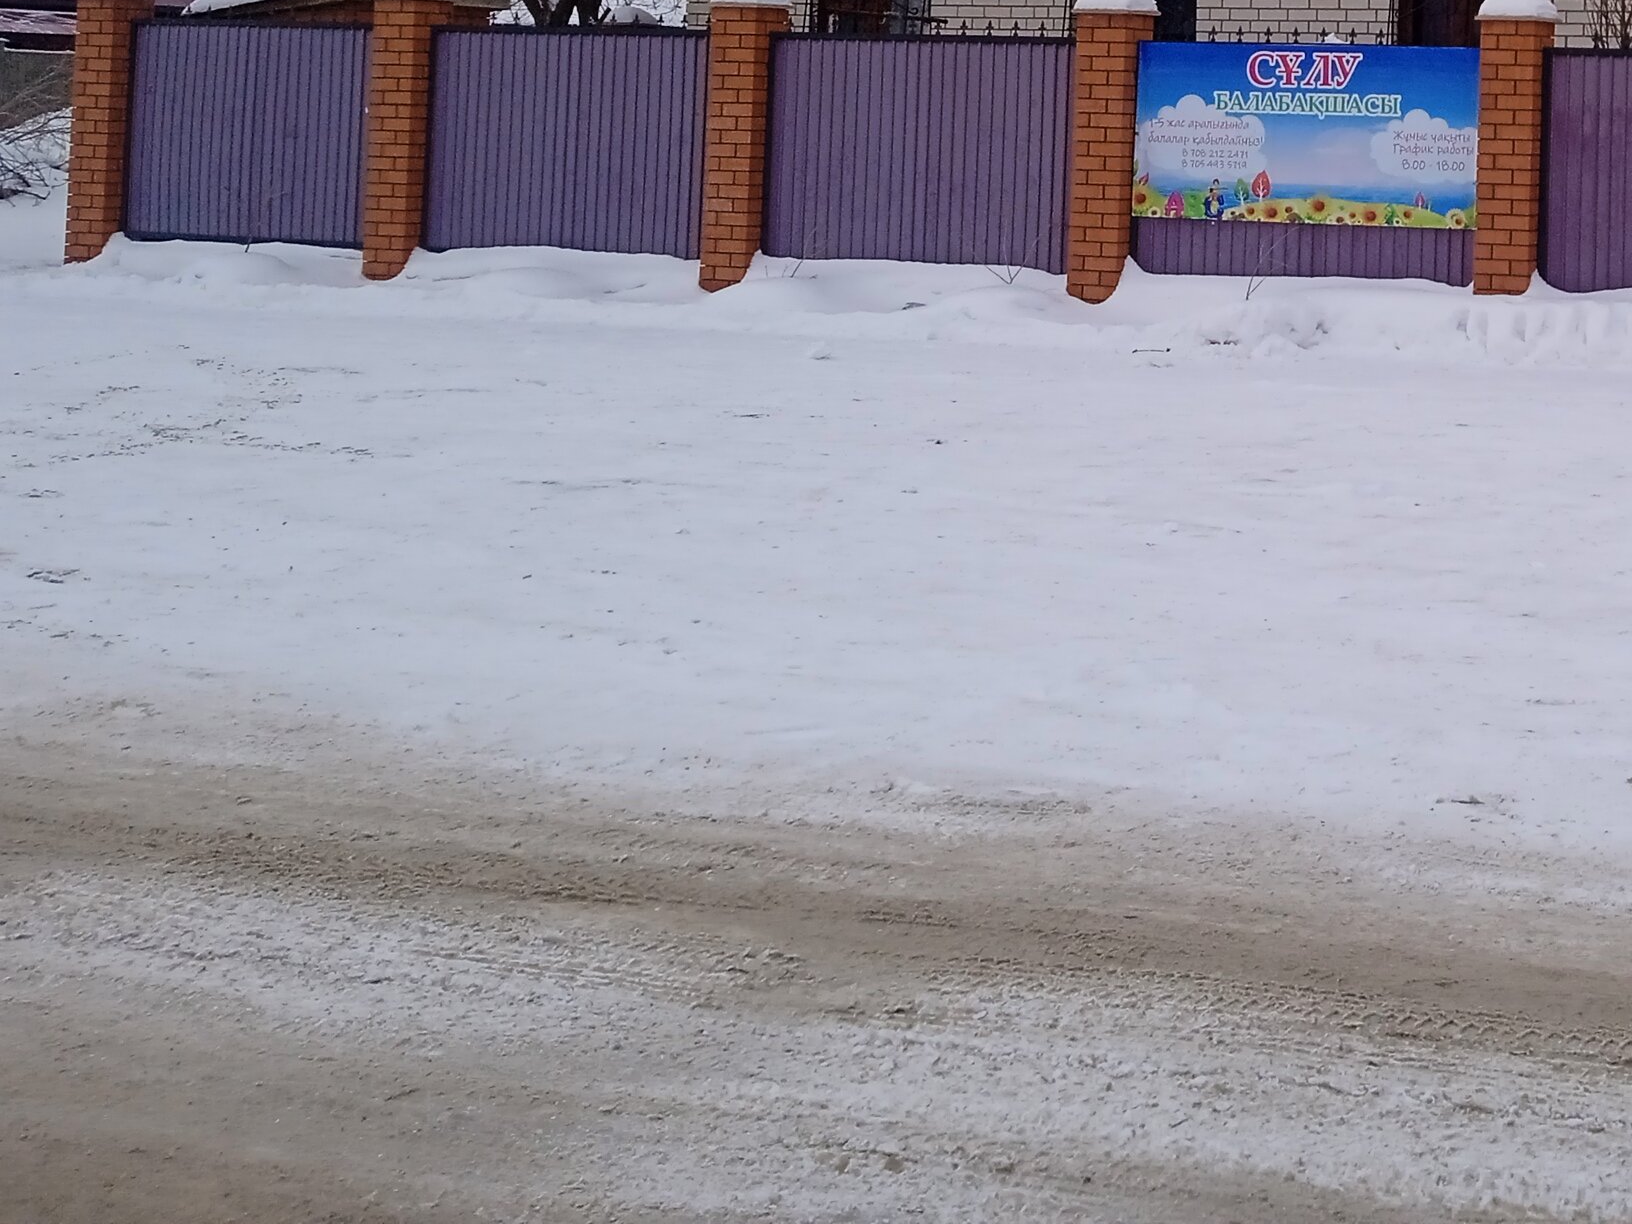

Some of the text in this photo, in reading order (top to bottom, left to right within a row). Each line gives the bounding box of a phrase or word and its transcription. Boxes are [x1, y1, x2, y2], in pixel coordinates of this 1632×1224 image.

[1247, 51, 1362, 89] СҰЛУ
[1214, 91, 1402, 118] БАЛАБАҚШАСЫ
[1148, 132, 1190, 145] балалар
[1209, 150, 1225, 158] 212
[1393, 142, 1474, 156] График работы
[1402, 158, 1426, 170] 8.00
[1437, 160, 1466, 171] 18.00
